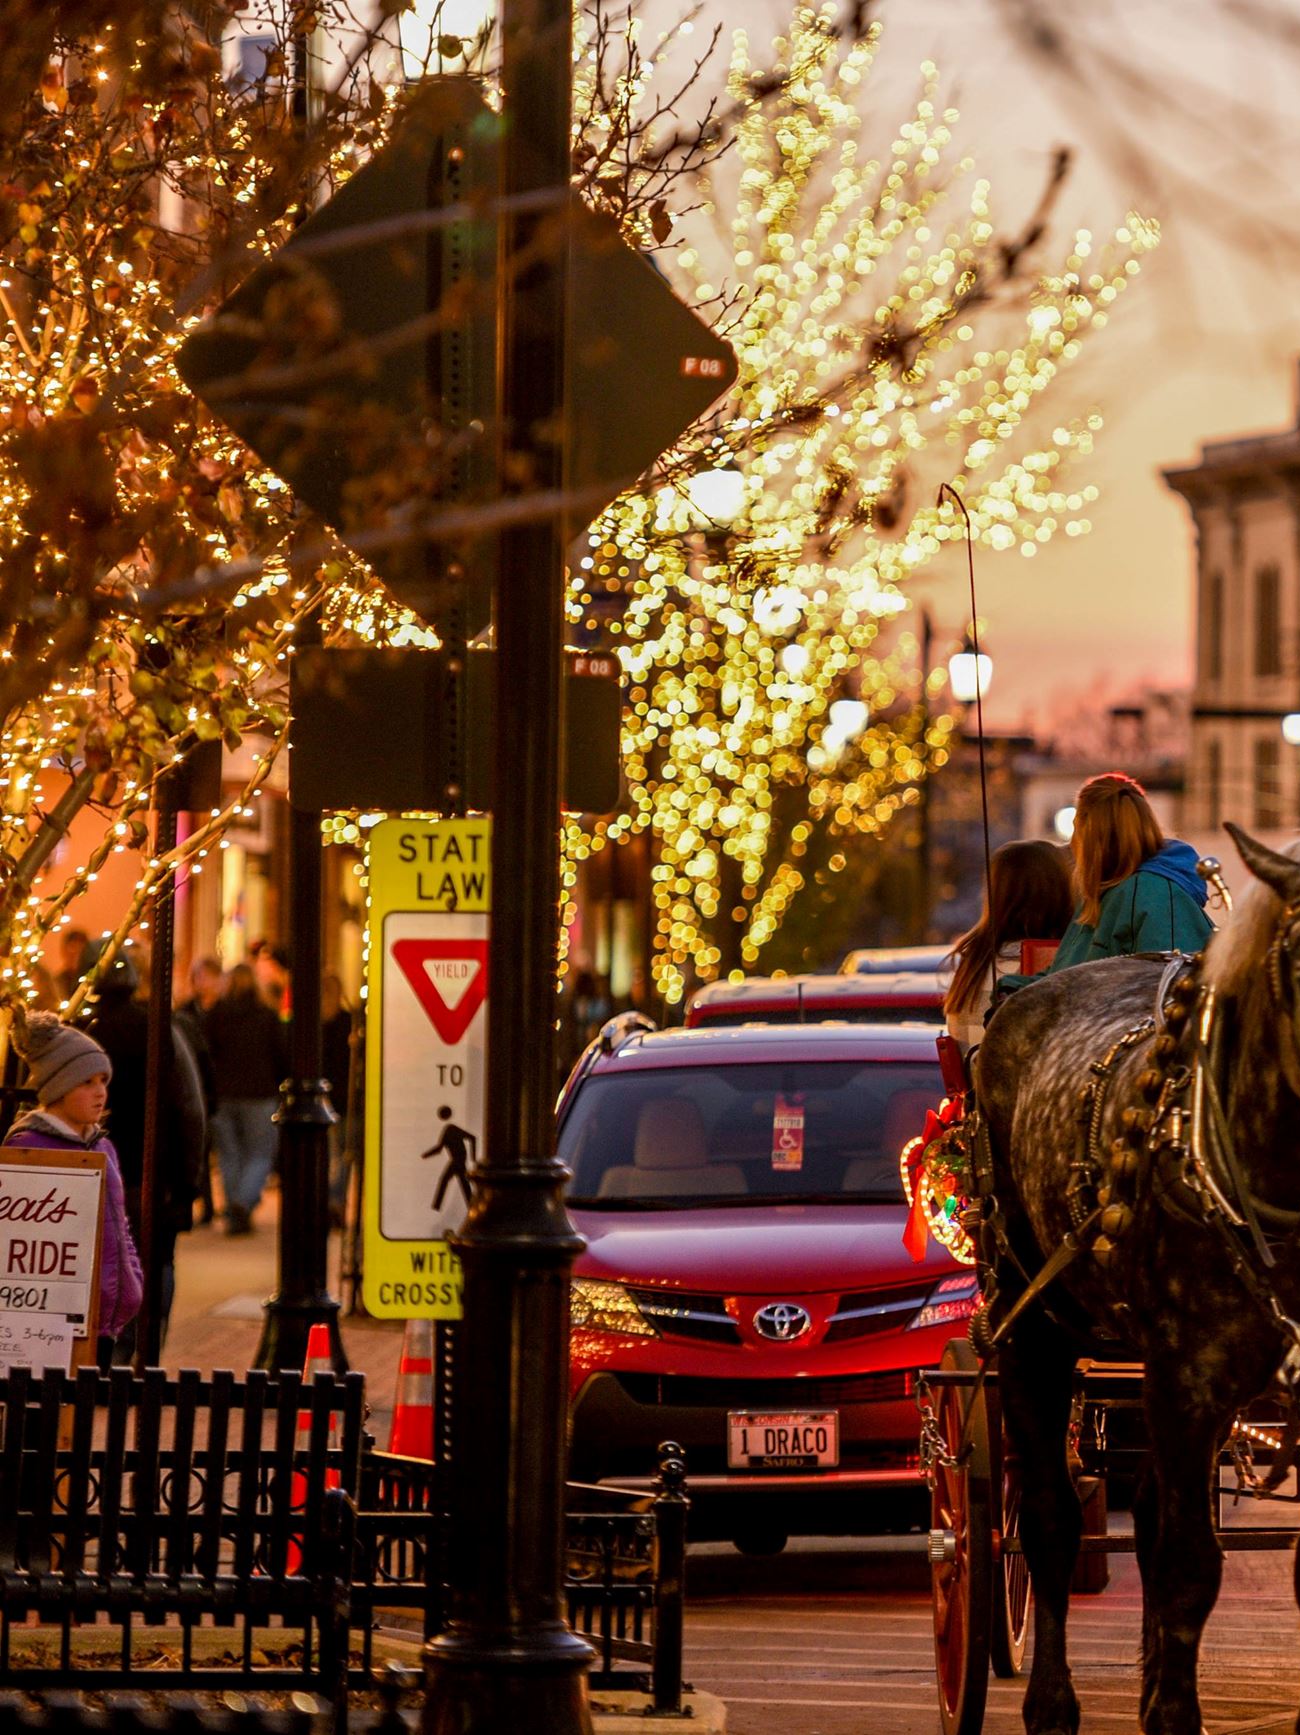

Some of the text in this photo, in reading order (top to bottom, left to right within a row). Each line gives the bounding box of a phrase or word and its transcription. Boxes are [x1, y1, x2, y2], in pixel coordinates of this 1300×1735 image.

[399, 833, 484, 863] STAT
[417, 872, 486, 901] LAW
[433, 963, 468, 979] YIELD
[435, 1063, 464, 1087] TO
[0, 1187, 78, 1224] eats
[7, 1239, 80, 1277] RIDE
[0, 1285, 48, 1311] 9801
[741, 1427, 828, 1455] 1 DRACO
